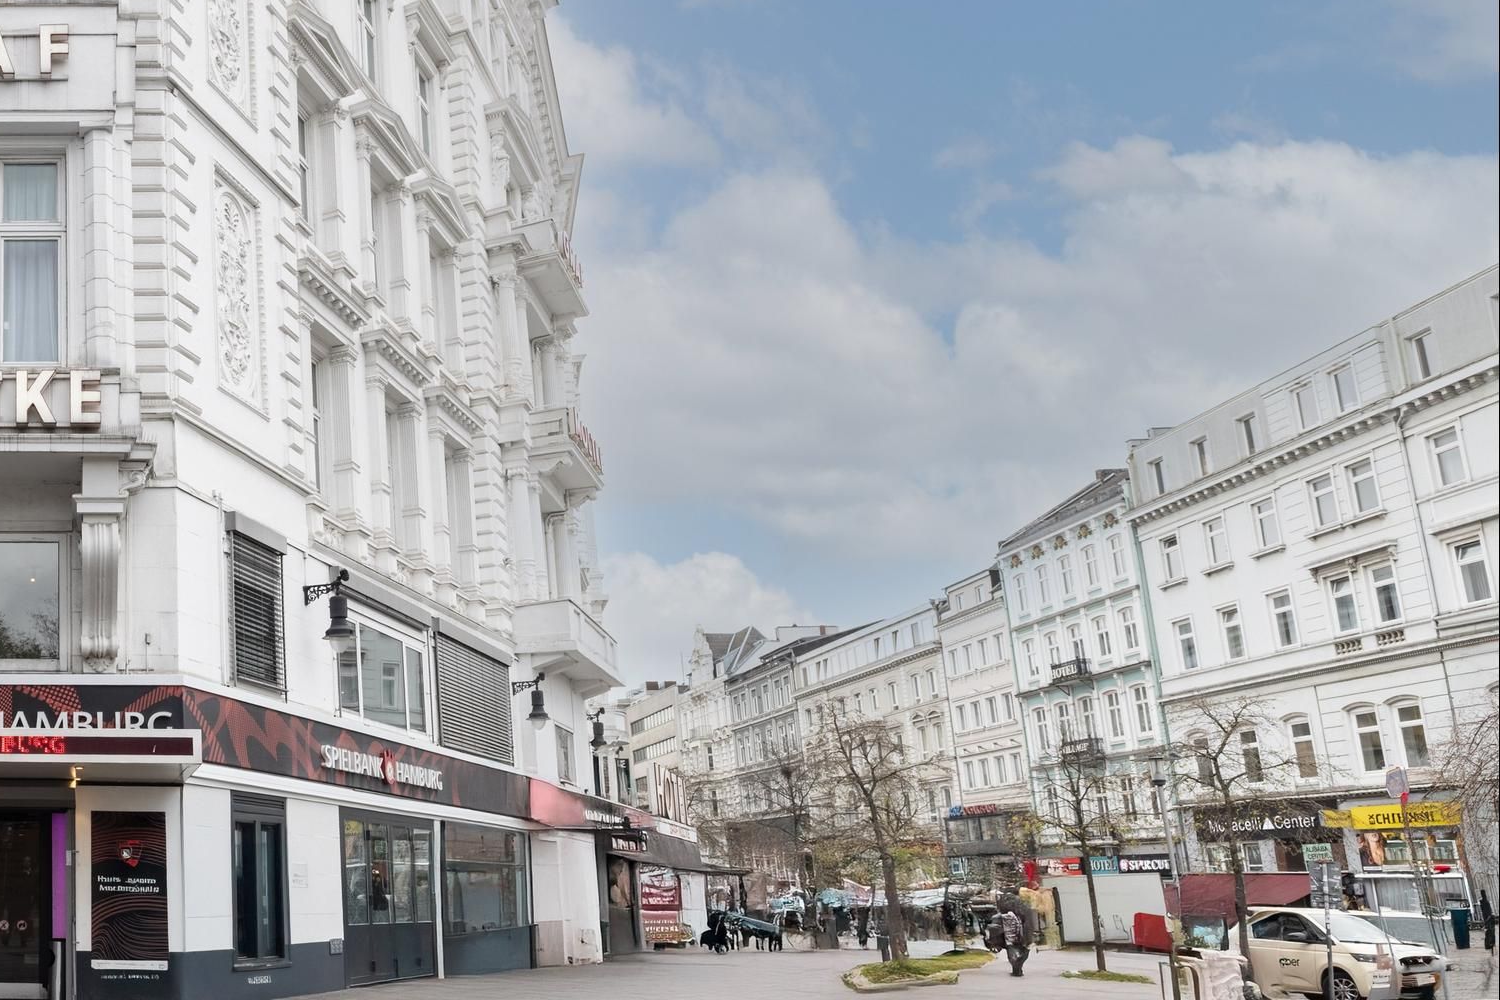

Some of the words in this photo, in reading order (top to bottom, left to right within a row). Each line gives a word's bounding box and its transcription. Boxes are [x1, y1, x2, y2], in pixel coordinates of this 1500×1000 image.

[321, 745, 385, 779] SPIELBANK
[395, 761, 443, 790] HAMBURG
[1274, 815, 1316, 829] Center
